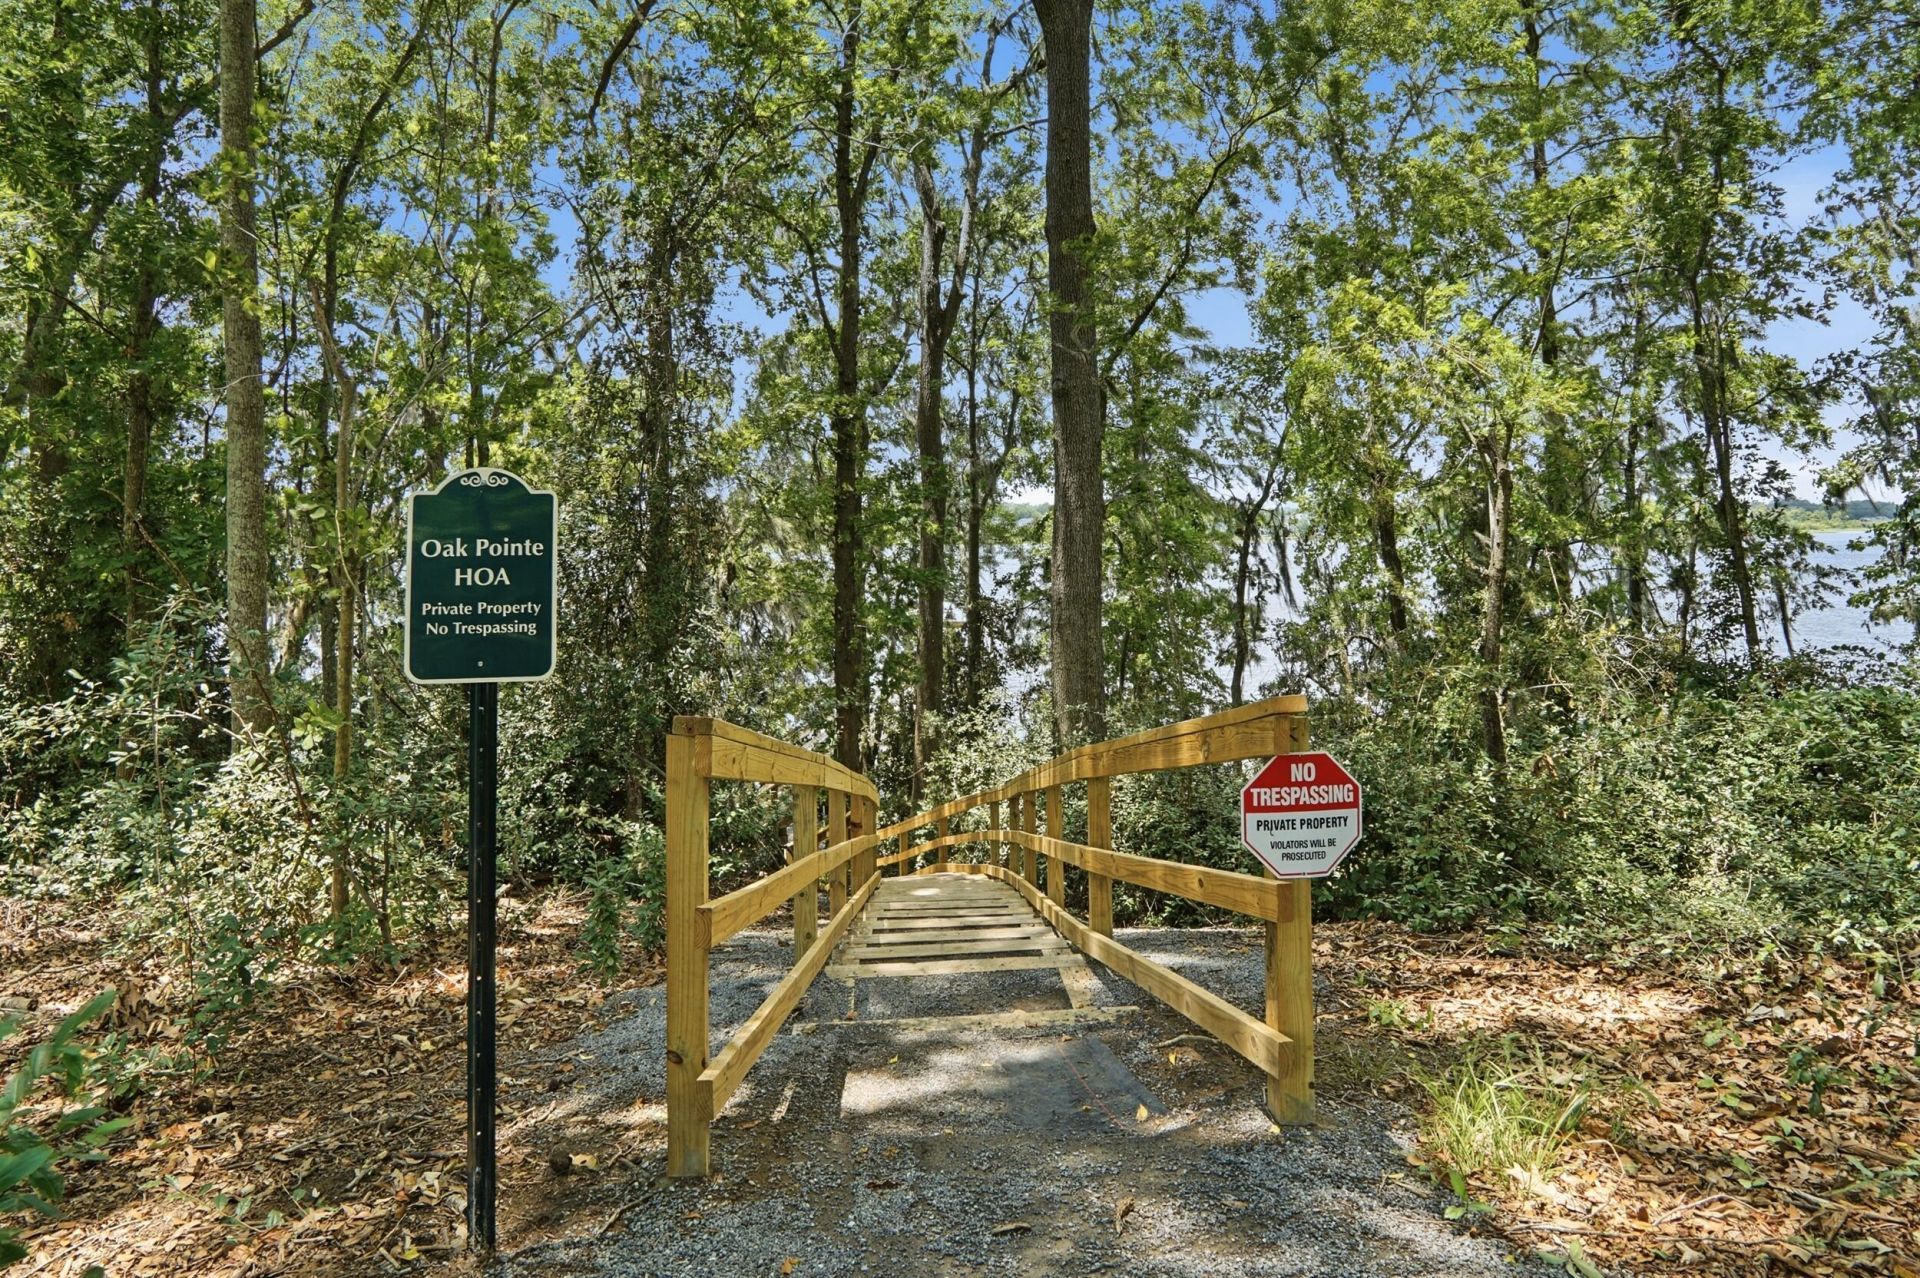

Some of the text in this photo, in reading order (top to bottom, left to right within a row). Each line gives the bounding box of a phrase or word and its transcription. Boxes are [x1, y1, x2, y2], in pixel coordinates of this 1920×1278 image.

[421, 537, 545, 558] Oak Pointe
[454, 567, 511, 586] HOA
[421, 601, 542, 617] Private Property
[426, 620, 537, 637] No Trespassing
[1290, 762, 1316, 783] NO
[1250, 783, 1354, 807] TRESPASSING
[1256, 815, 1349, 831] PRIVATE PROPERTY
[1270, 838, 1337, 850] VIOLATORS WILL BE
[1281, 850, 1327, 861] PROSECUTED
